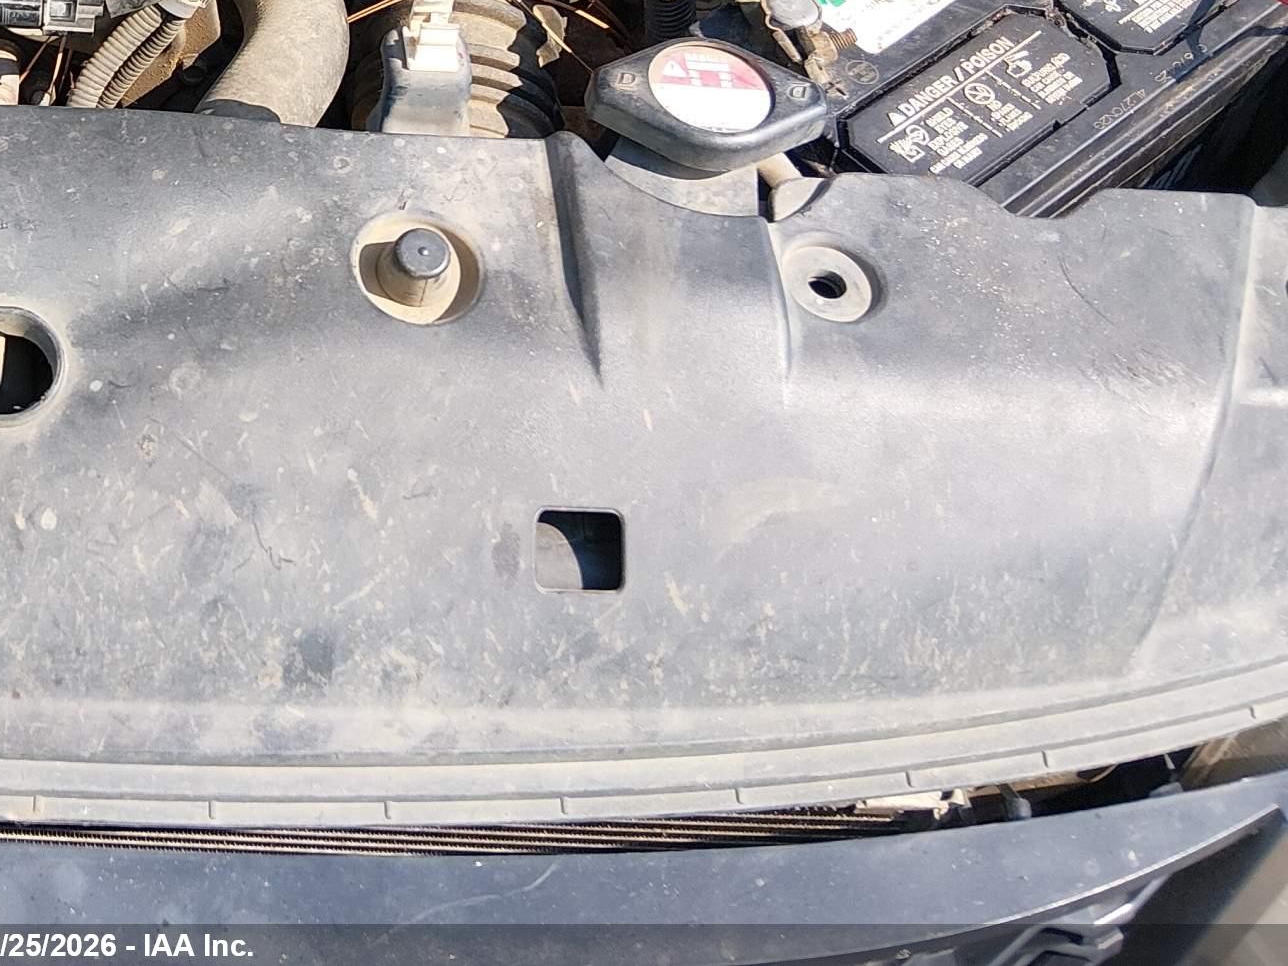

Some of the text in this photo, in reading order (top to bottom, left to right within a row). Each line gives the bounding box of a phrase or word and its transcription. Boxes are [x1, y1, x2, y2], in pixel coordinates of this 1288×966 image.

[617, 72, 636, 86] D
[898, 75, 958, 117] DANGER
[961, 36, 1015, 74] POISON
